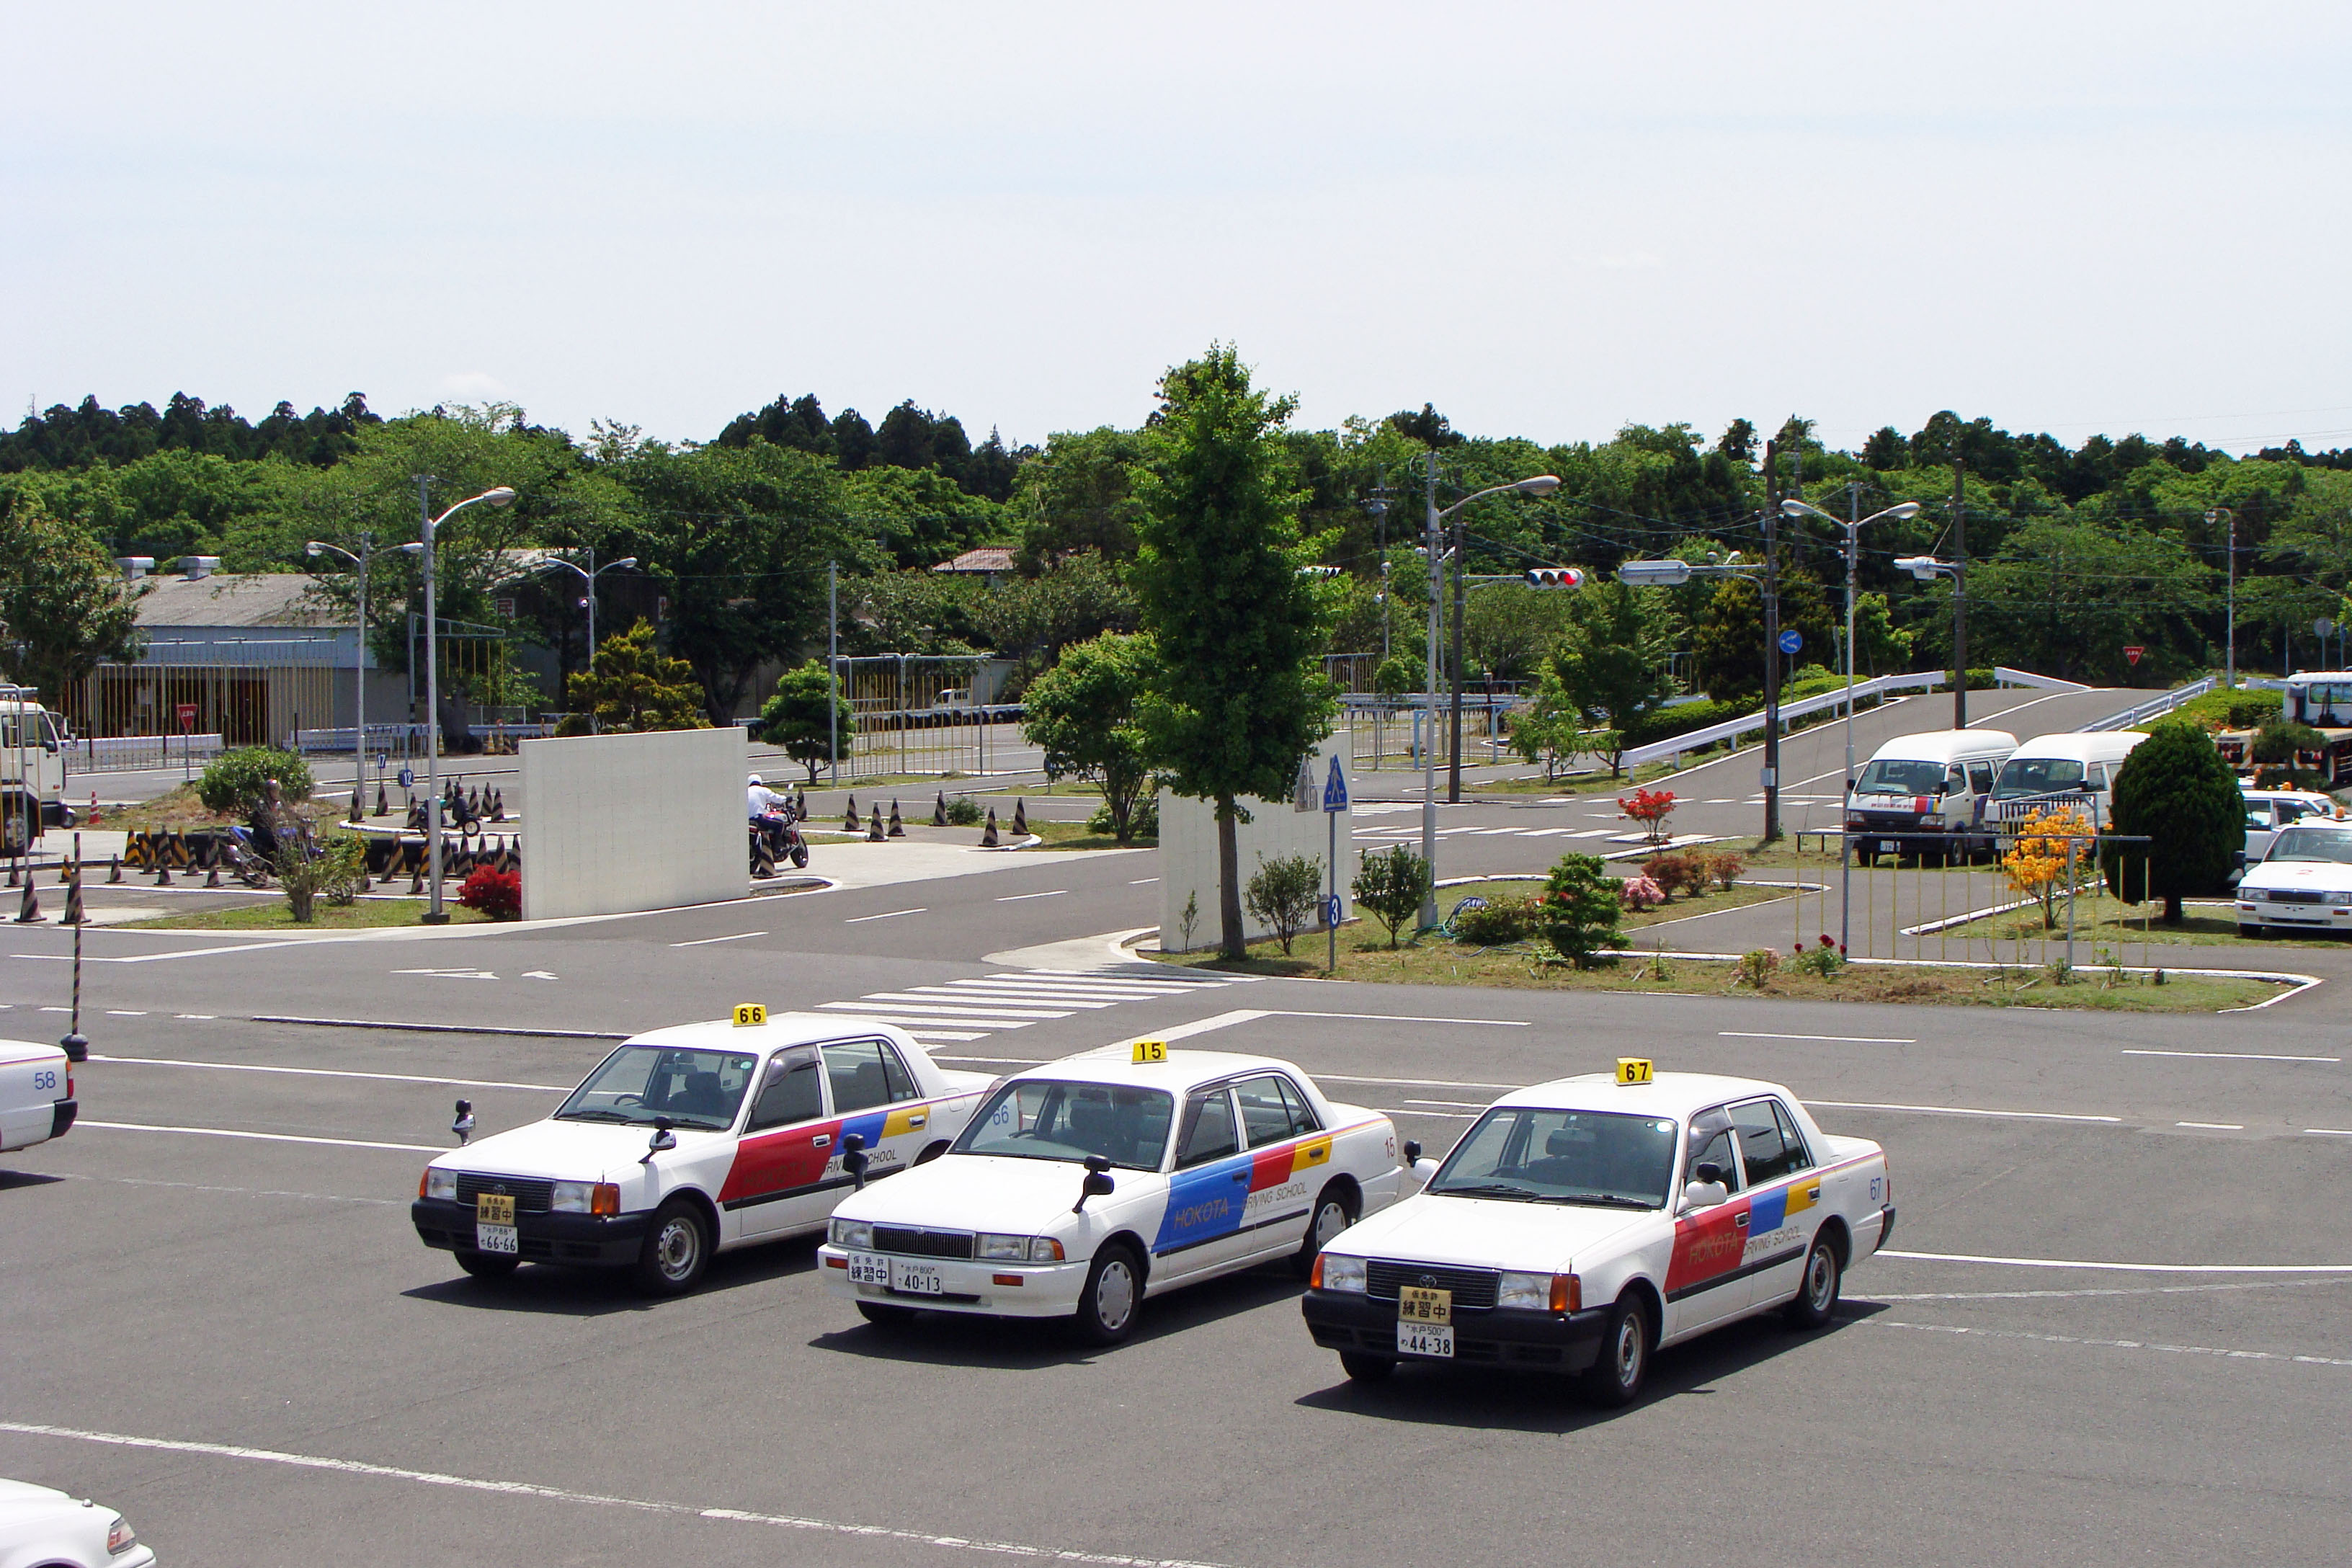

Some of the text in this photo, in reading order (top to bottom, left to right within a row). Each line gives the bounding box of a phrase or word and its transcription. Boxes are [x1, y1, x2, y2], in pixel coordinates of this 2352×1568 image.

[378, 754, 386, 767] 17
[404, 771, 412, 785] 12
[1332, 898, 1338, 925] 3
[740, 1007, 761, 1023] 66
[1140, 1043, 1161, 1061] 15
[35, 1071, 56, 1090] 58
[1626, 1062, 1648, 1081] 67
[993, 1105, 1009, 1126] 66
[867, 1149, 897, 1165] CHOOL
[1385, 1136, 1395, 1159] 15
[1870, 1177, 1881, 1200] 67
[480, 1206, 512, 1221] 練習中
[1174, 1182, 1307, 1229] HOKOTA DRIVING SCHOOL
[1688, 1231, 1739, 1265] HOKOTA
[1773, 1225, 1801, 1246] SCHOOL
[851, 1265, 887, 1283] 練習中
[904, 1274, 940, 1292] 40-13
[1402, 1300, 1446, 1319] 練習中
[1410, 1335, 1451, 1354] 44-38
